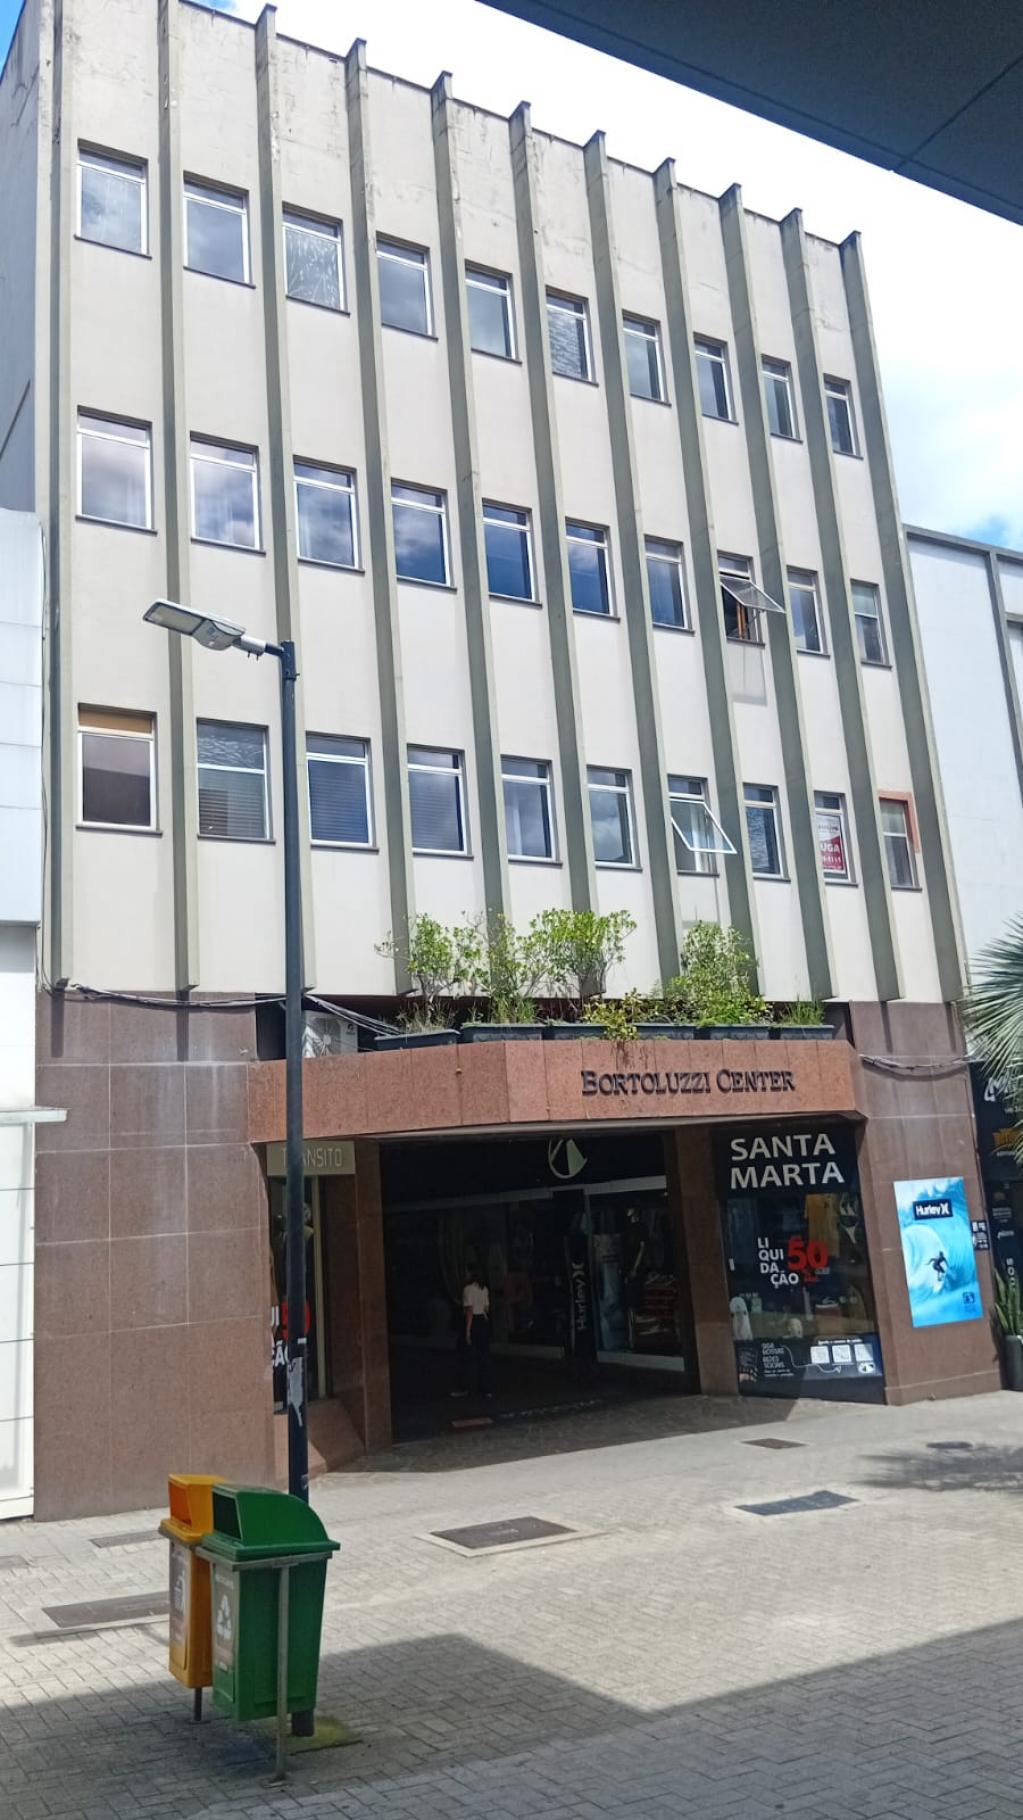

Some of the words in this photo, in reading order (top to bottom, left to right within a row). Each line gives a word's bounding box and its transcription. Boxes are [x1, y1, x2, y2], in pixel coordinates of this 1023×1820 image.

[581, 1070, 711, 1095] BORTOLUZZI
[716, 1068, 796, 1093] CENTER
[730, 1133, 836, 1161] SANTA
[282, 1147, 343, 1168] TNSITO
[730, 1161, 845, 1190] MARTA
[915, 1204, 942, 1216] Hurley
[757, 1237, 769, 1249] LI
[787, 1235, 829, 1270] 50
[758, 1249, 784, 1261] QUI
[760, 1262, 779, 1273] DA
[770, 1270, 800, 1289] ÇÃO
